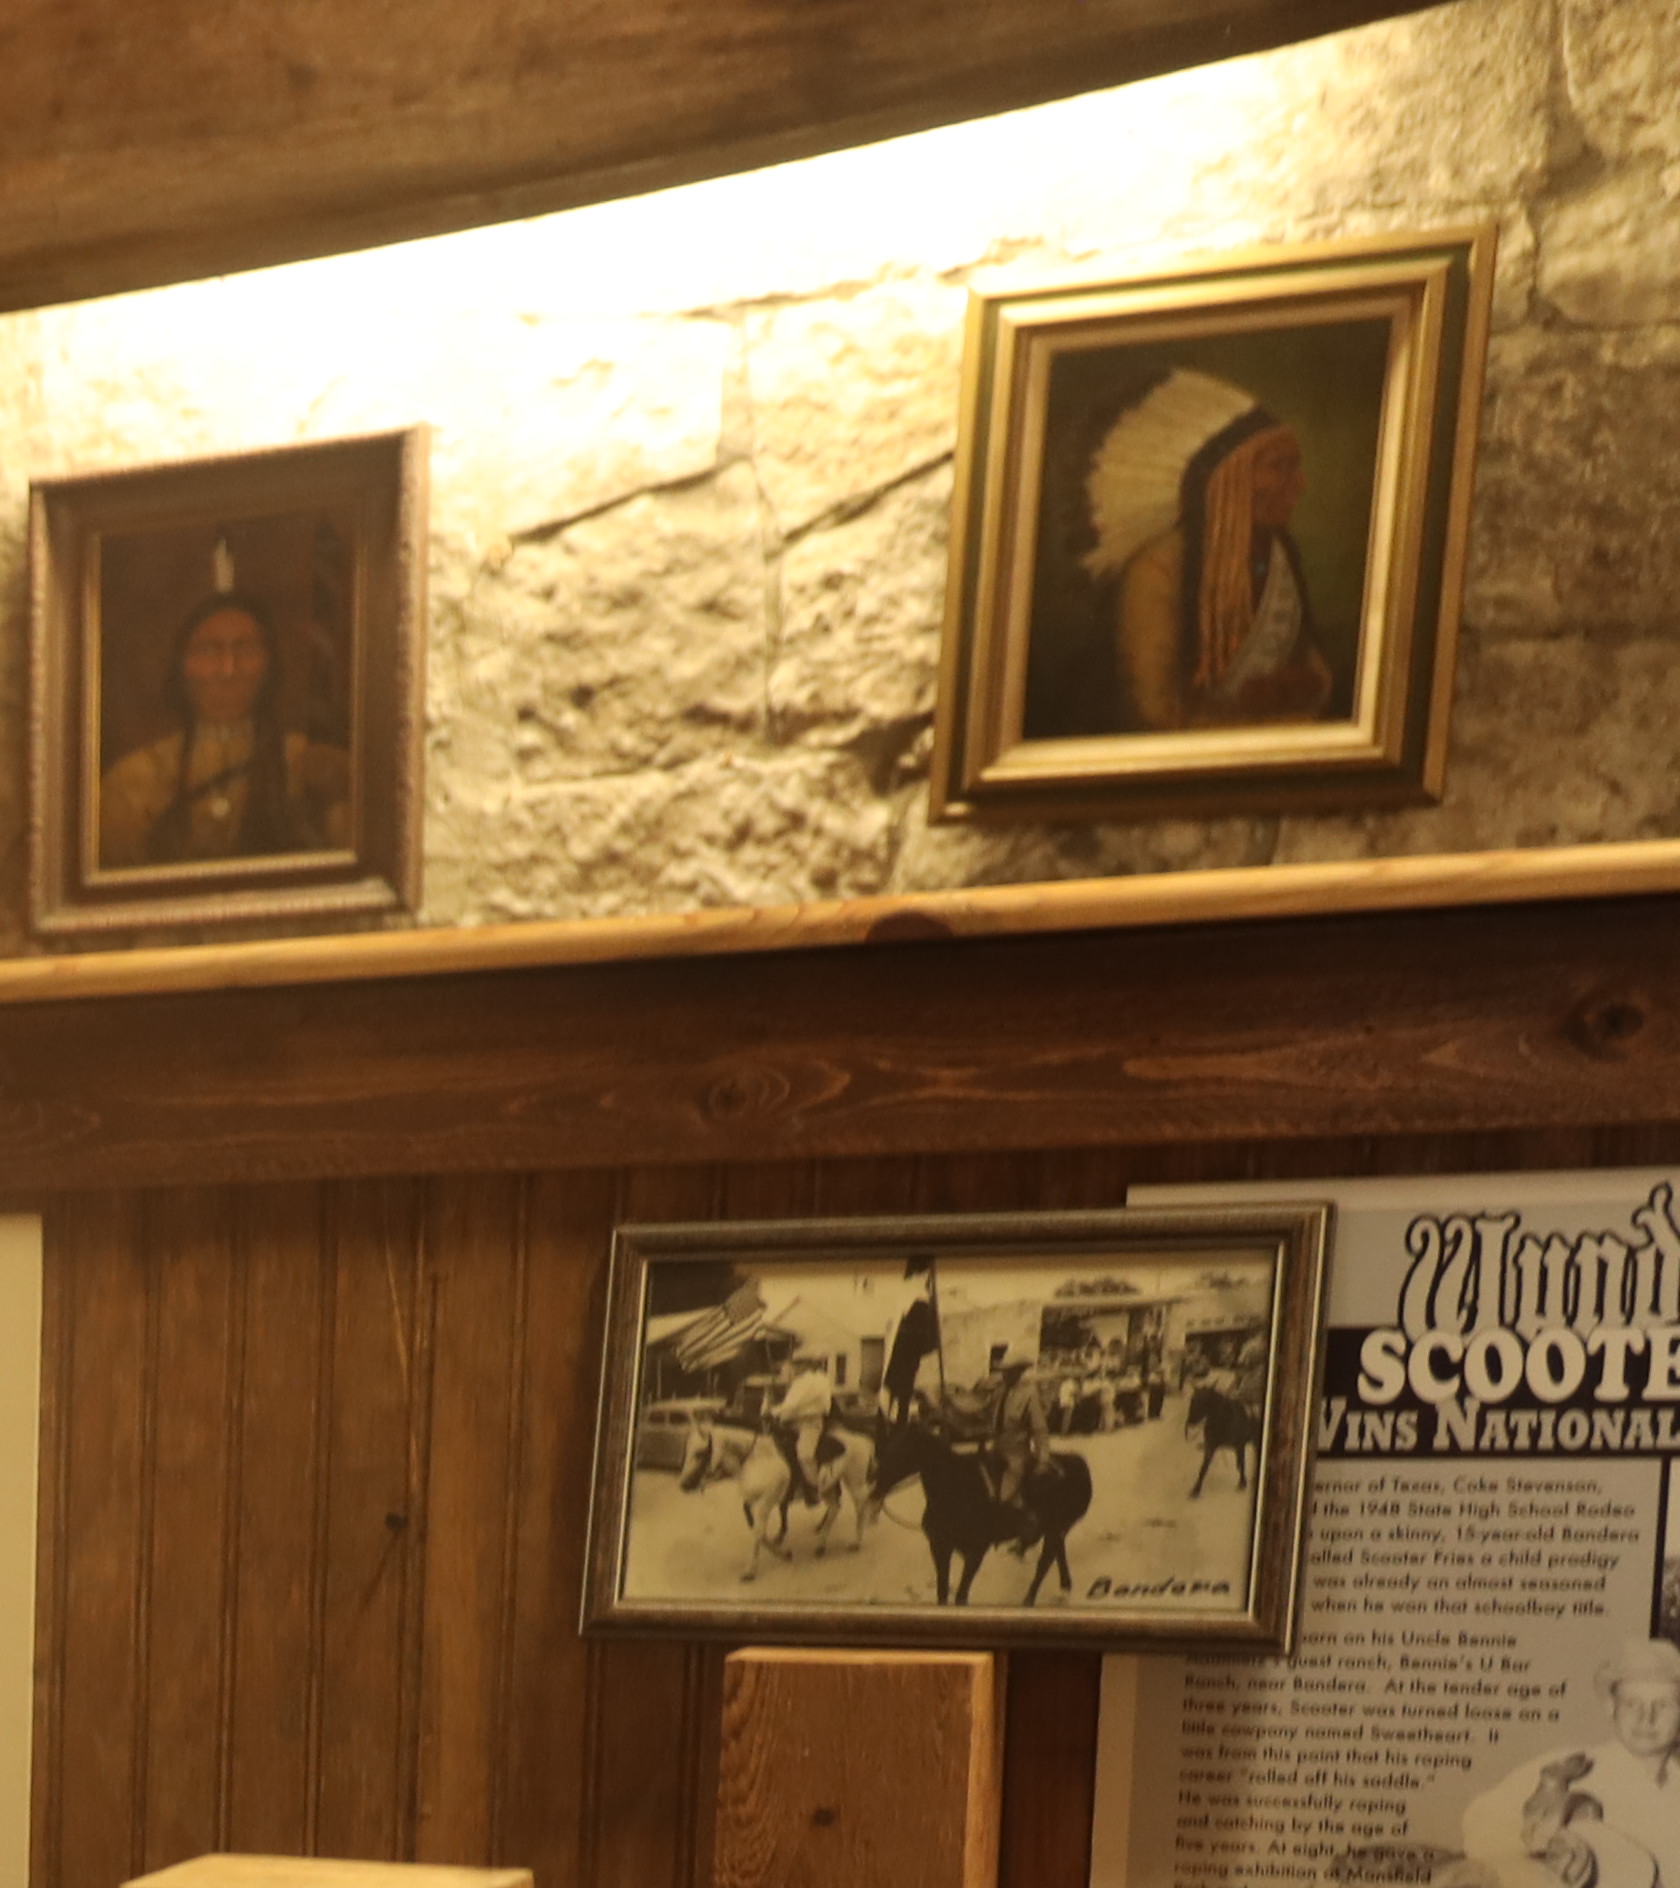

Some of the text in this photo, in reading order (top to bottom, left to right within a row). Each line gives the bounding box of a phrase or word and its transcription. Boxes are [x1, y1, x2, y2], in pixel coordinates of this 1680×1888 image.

[1357, 1326, 1680, 1405] SCOOTE
[1433, 1399, 1680, 1450] NATIONAL
[1323, 1499, 1634, 1520] the 1948 State High School Rodeo
[1313, 1572, 1606, 1593] was already an almost seasoned
[1311, 1596, 1356, 1612] when
[1363, 1596, 1383, 1612] he
[1391, 1601, 1427, 1613] won
[1433, 1597, 1467, 1614] that
[1474, 1597, 1565, 1619] schoolboy
